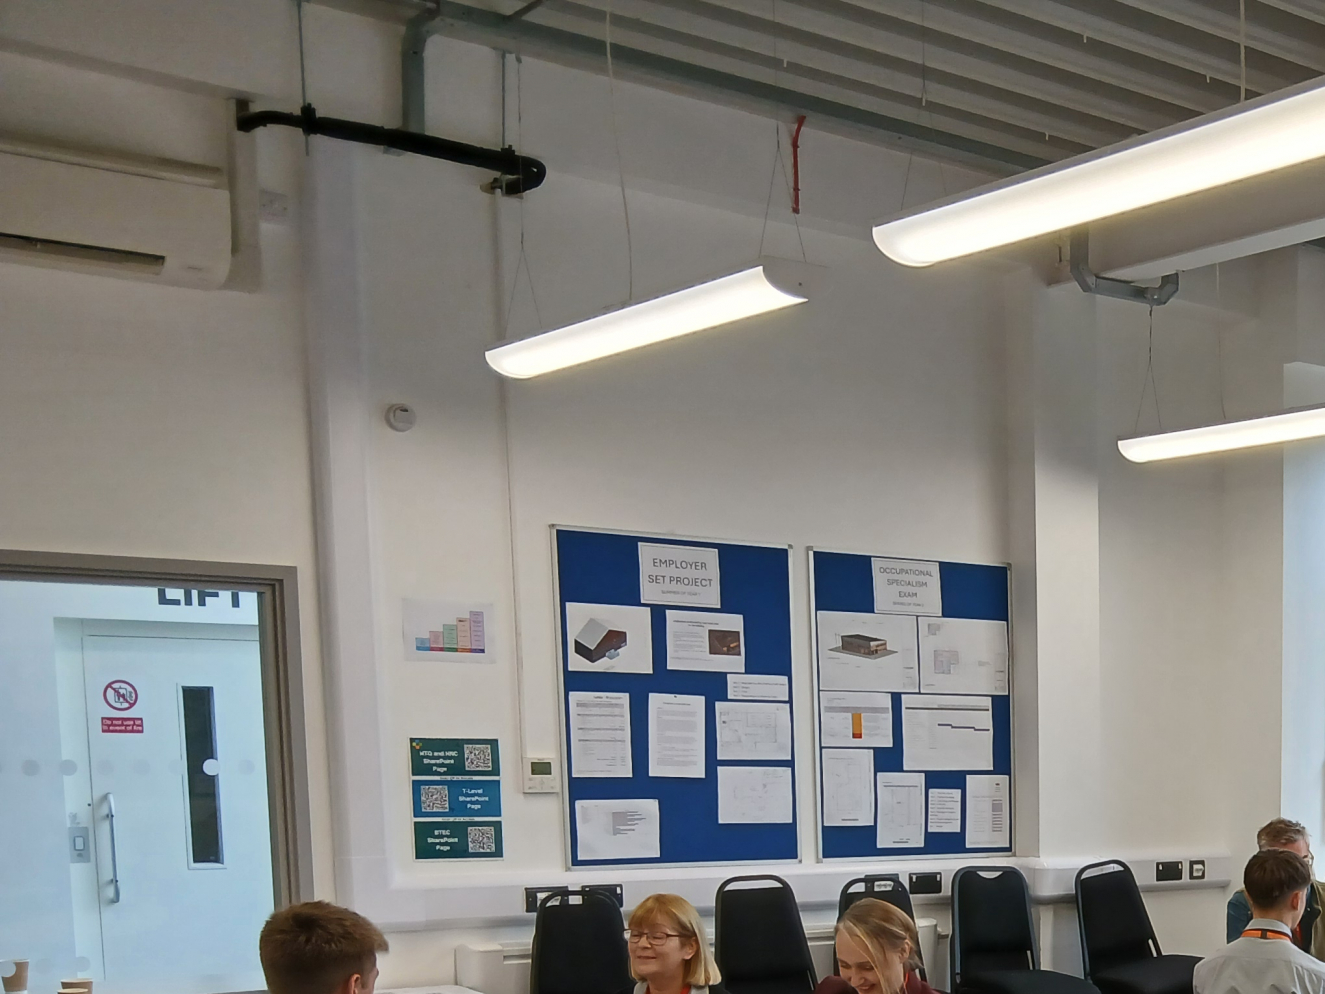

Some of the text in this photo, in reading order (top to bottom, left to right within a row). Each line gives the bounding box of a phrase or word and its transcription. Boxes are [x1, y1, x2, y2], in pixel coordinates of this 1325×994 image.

[652, 557, 708, 571] EMPLOYER
[879, 566, 934, 578] OCCUPATIONAL
[647, 574, 713, 588] SET PROJECT
[886, 578, 928, 588] SPECIALISM
[898, 590, 918, 598] EXAM
